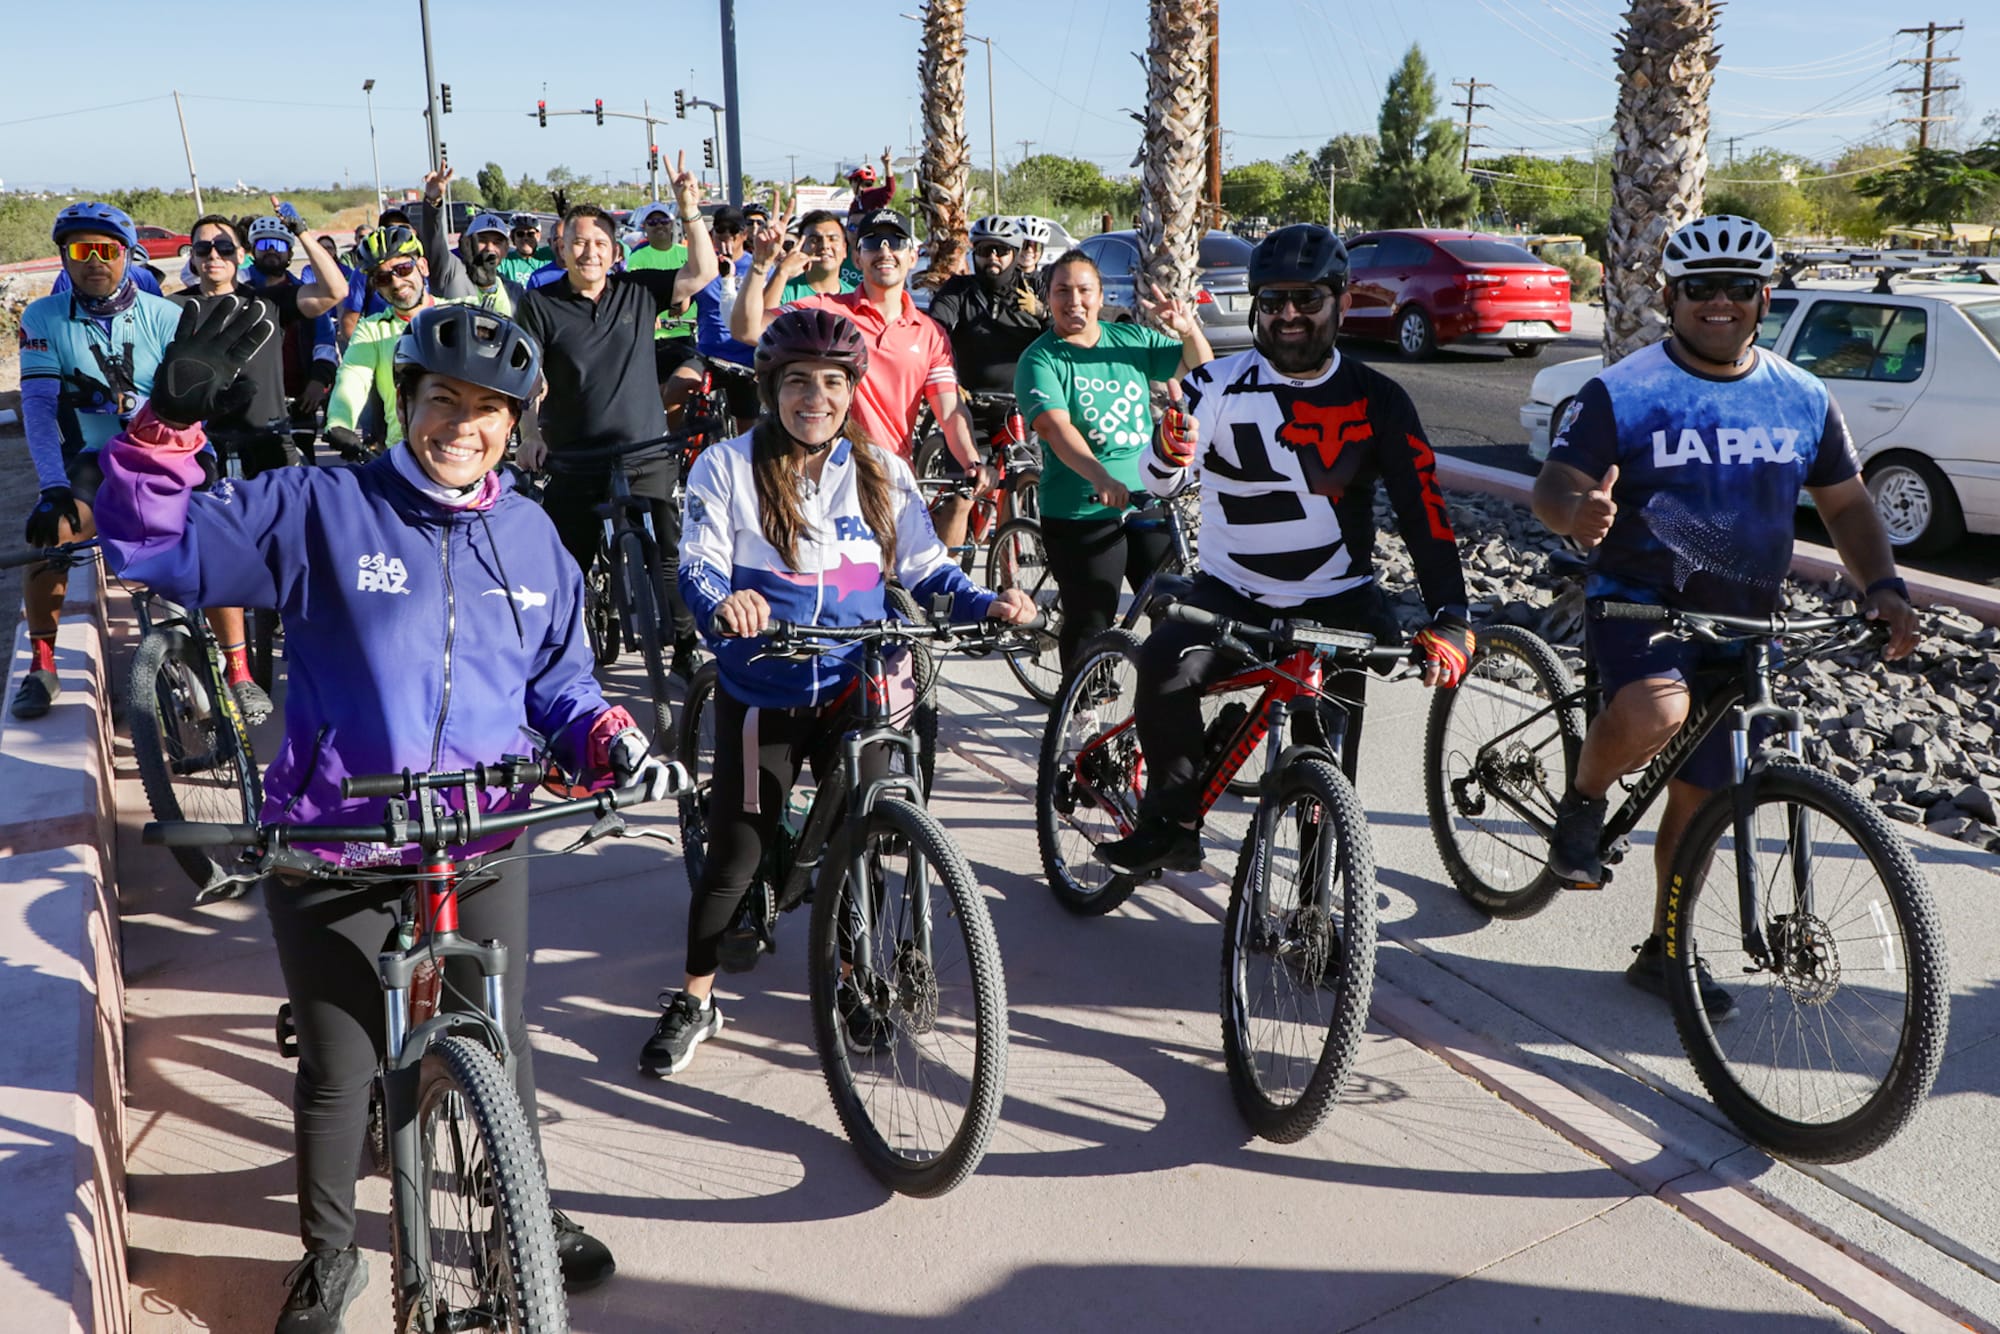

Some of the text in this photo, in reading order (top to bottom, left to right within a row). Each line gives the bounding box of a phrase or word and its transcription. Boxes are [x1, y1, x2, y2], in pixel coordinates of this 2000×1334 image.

[1652, 428, 1712, 468] LA
[1716, 426, 1806, 464] PAZ
[834, 515, 876, 541] PA
[357, 569, 412, 595] PAZ
[1666, 873, 1682, 959] MAXXIS
